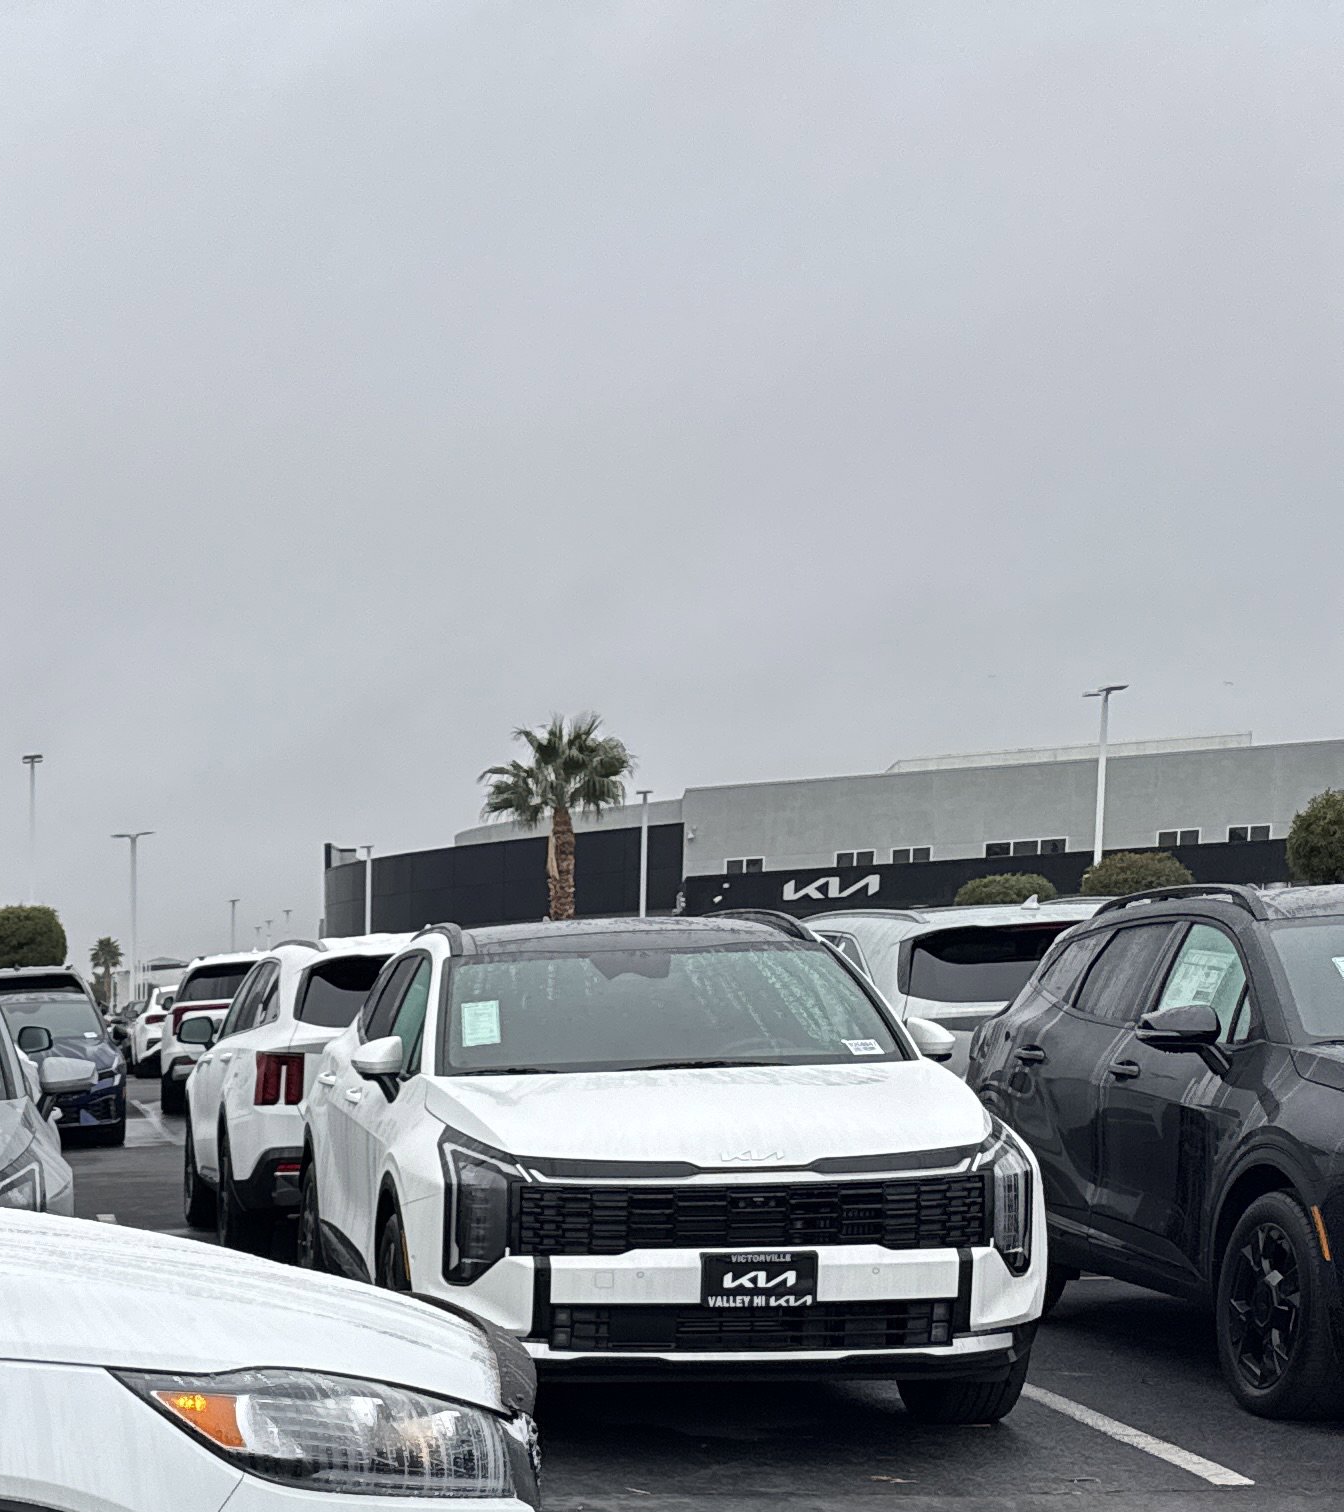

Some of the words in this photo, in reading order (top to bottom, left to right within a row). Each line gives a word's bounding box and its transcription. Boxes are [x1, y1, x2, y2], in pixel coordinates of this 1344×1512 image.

[782, 874, 880, 901] KIA
[731, 1253, 792, 1263] VICTORVILLE
[722, 1270, 797, 1289] KIA
[707, 1296, 751, 1308] VALLEY
[769, 1294, 813, 1307] KIA
